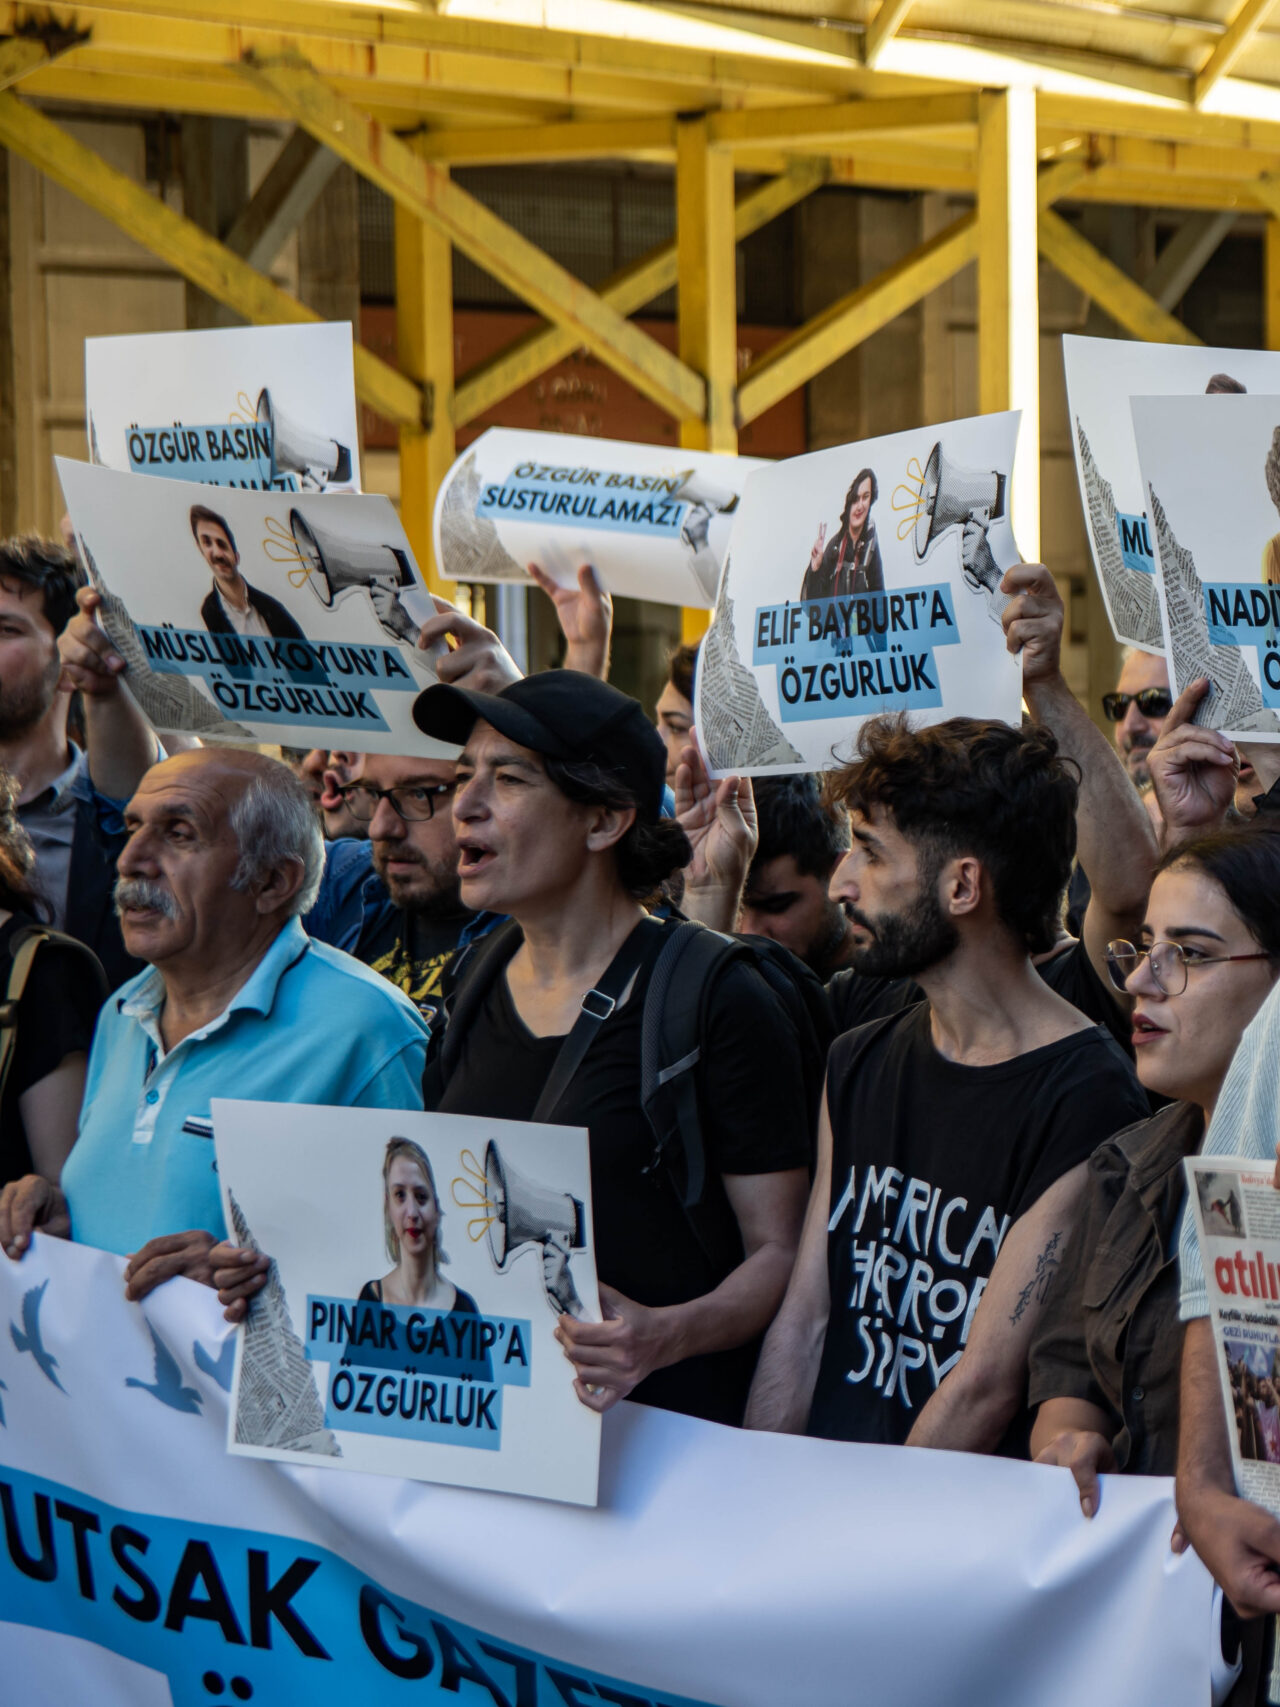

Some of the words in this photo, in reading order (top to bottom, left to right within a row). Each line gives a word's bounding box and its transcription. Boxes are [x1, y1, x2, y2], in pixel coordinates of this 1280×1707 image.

[129, 421, 204, 465] ÖZGÜR
[207, 426, 271, 461] BASIN
[514, 462, 600, 487] ÖZGÜR
[604, 472, 680, 493] BASIN
[482, 486, 682, 527] SUSTURULAMAZ!
[756, 600, 803, 648] ELİF
[808, 588, 953, 642] BAYBURT'A
[264, 640, 410, 679] KOYUN'A
[779, 644, 936, 705] ÖZGÜRLÜK
[212, 672, 381, 720] ÖZGÜRLÜK
[310, 1301, 399, 1351] PINAR
[405, 1316, 528, 1367] GAYIP'A
[331, 1358, 499, 1431] ÖZGÜRLÜK
